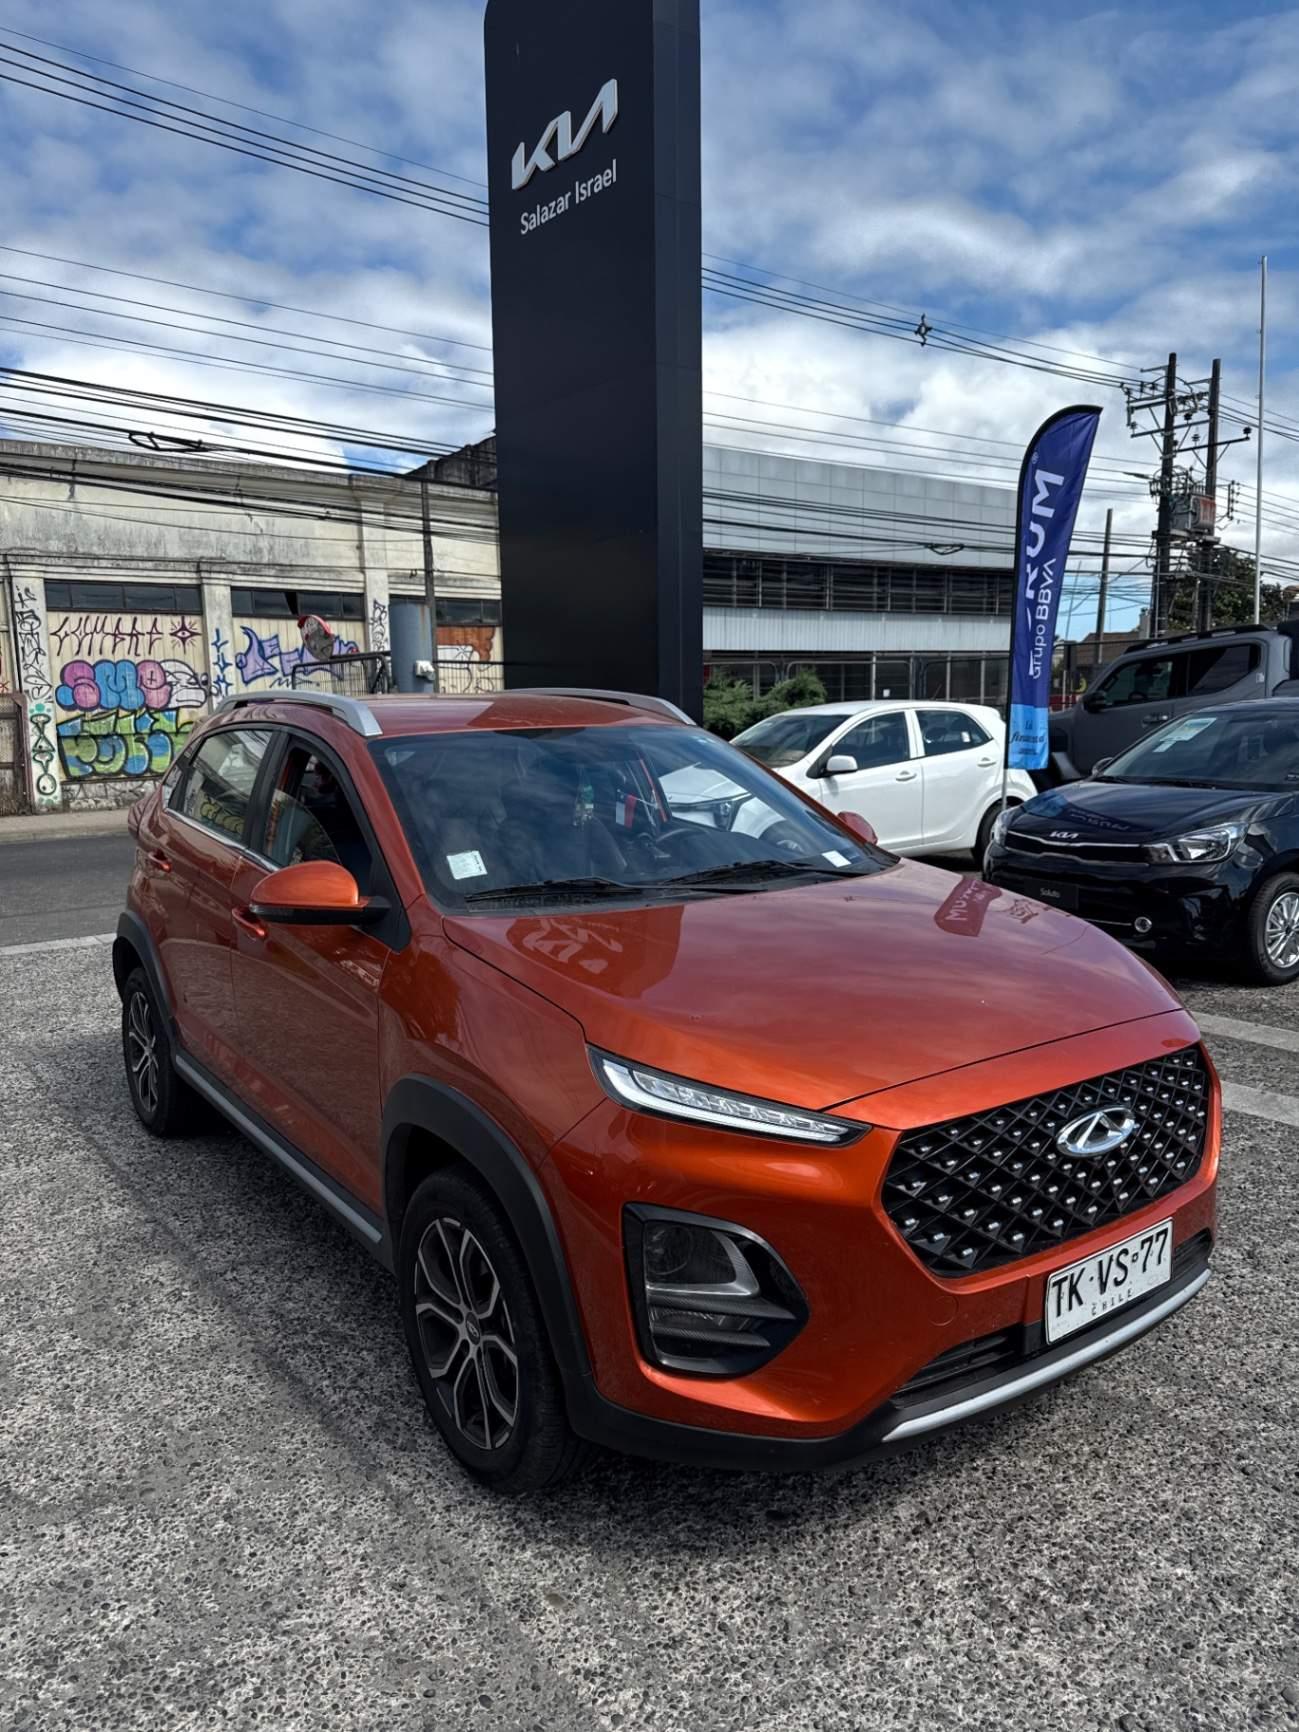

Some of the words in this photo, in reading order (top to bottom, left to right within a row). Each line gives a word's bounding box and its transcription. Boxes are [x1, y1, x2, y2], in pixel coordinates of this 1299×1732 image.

[511, 78, 618, 190] KIA
[520, 191, 571, 235] Salazar
[575, 158, 617, 204] Israel
[1035, 558, 1056, 621] BBVA
[1033, 624, 1047, 680] Grupo
[1049, 831, 1079, 839] KIA
[1091, 1288, 1133, 1316] CHILE
